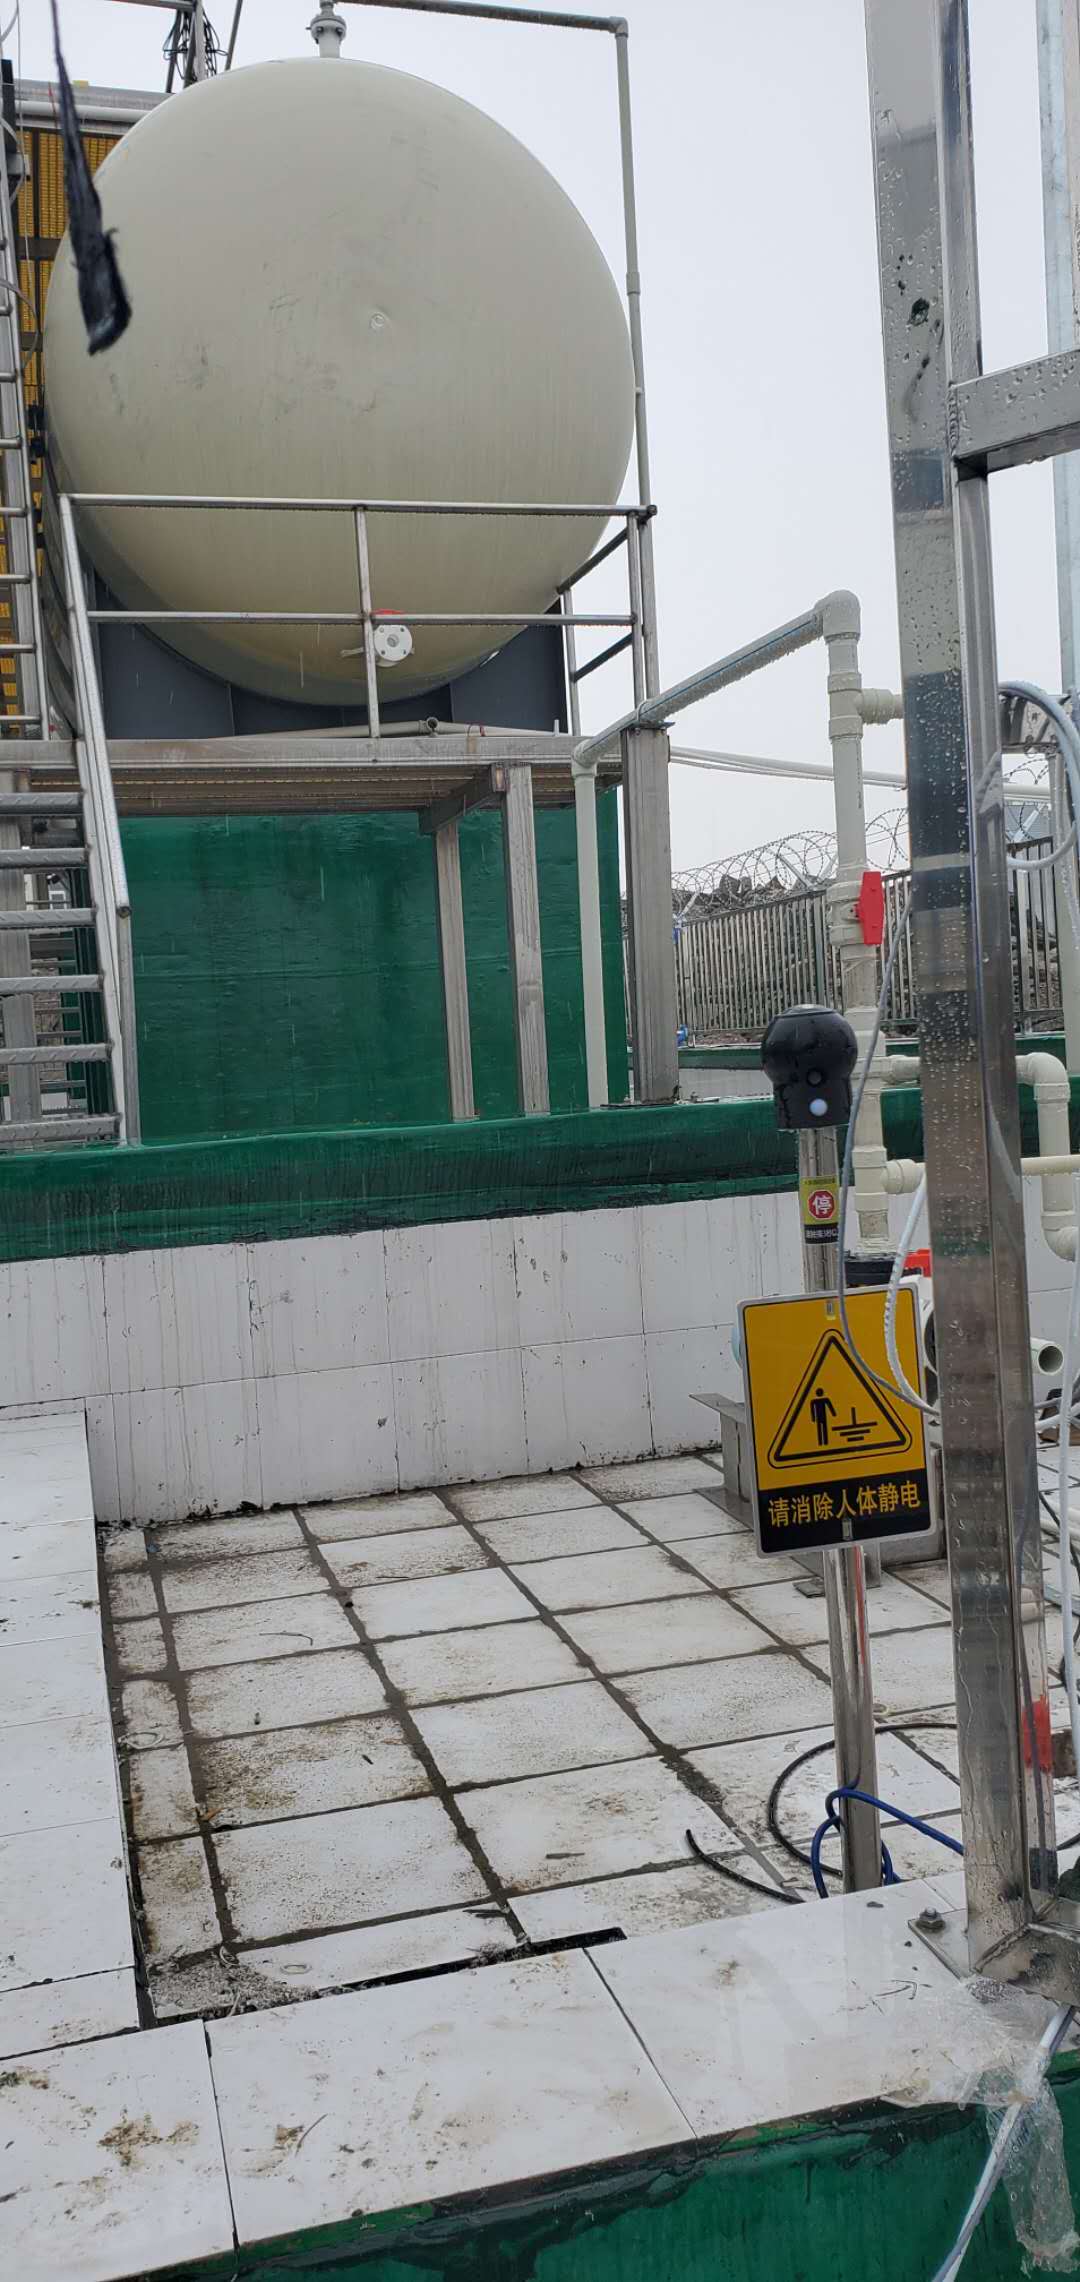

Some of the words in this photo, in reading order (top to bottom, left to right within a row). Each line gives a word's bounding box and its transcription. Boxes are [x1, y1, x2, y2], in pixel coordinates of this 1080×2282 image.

[812, 1194, 832, 1215] 停
[768, 1480, 920, 1527] 请消除人体静电
